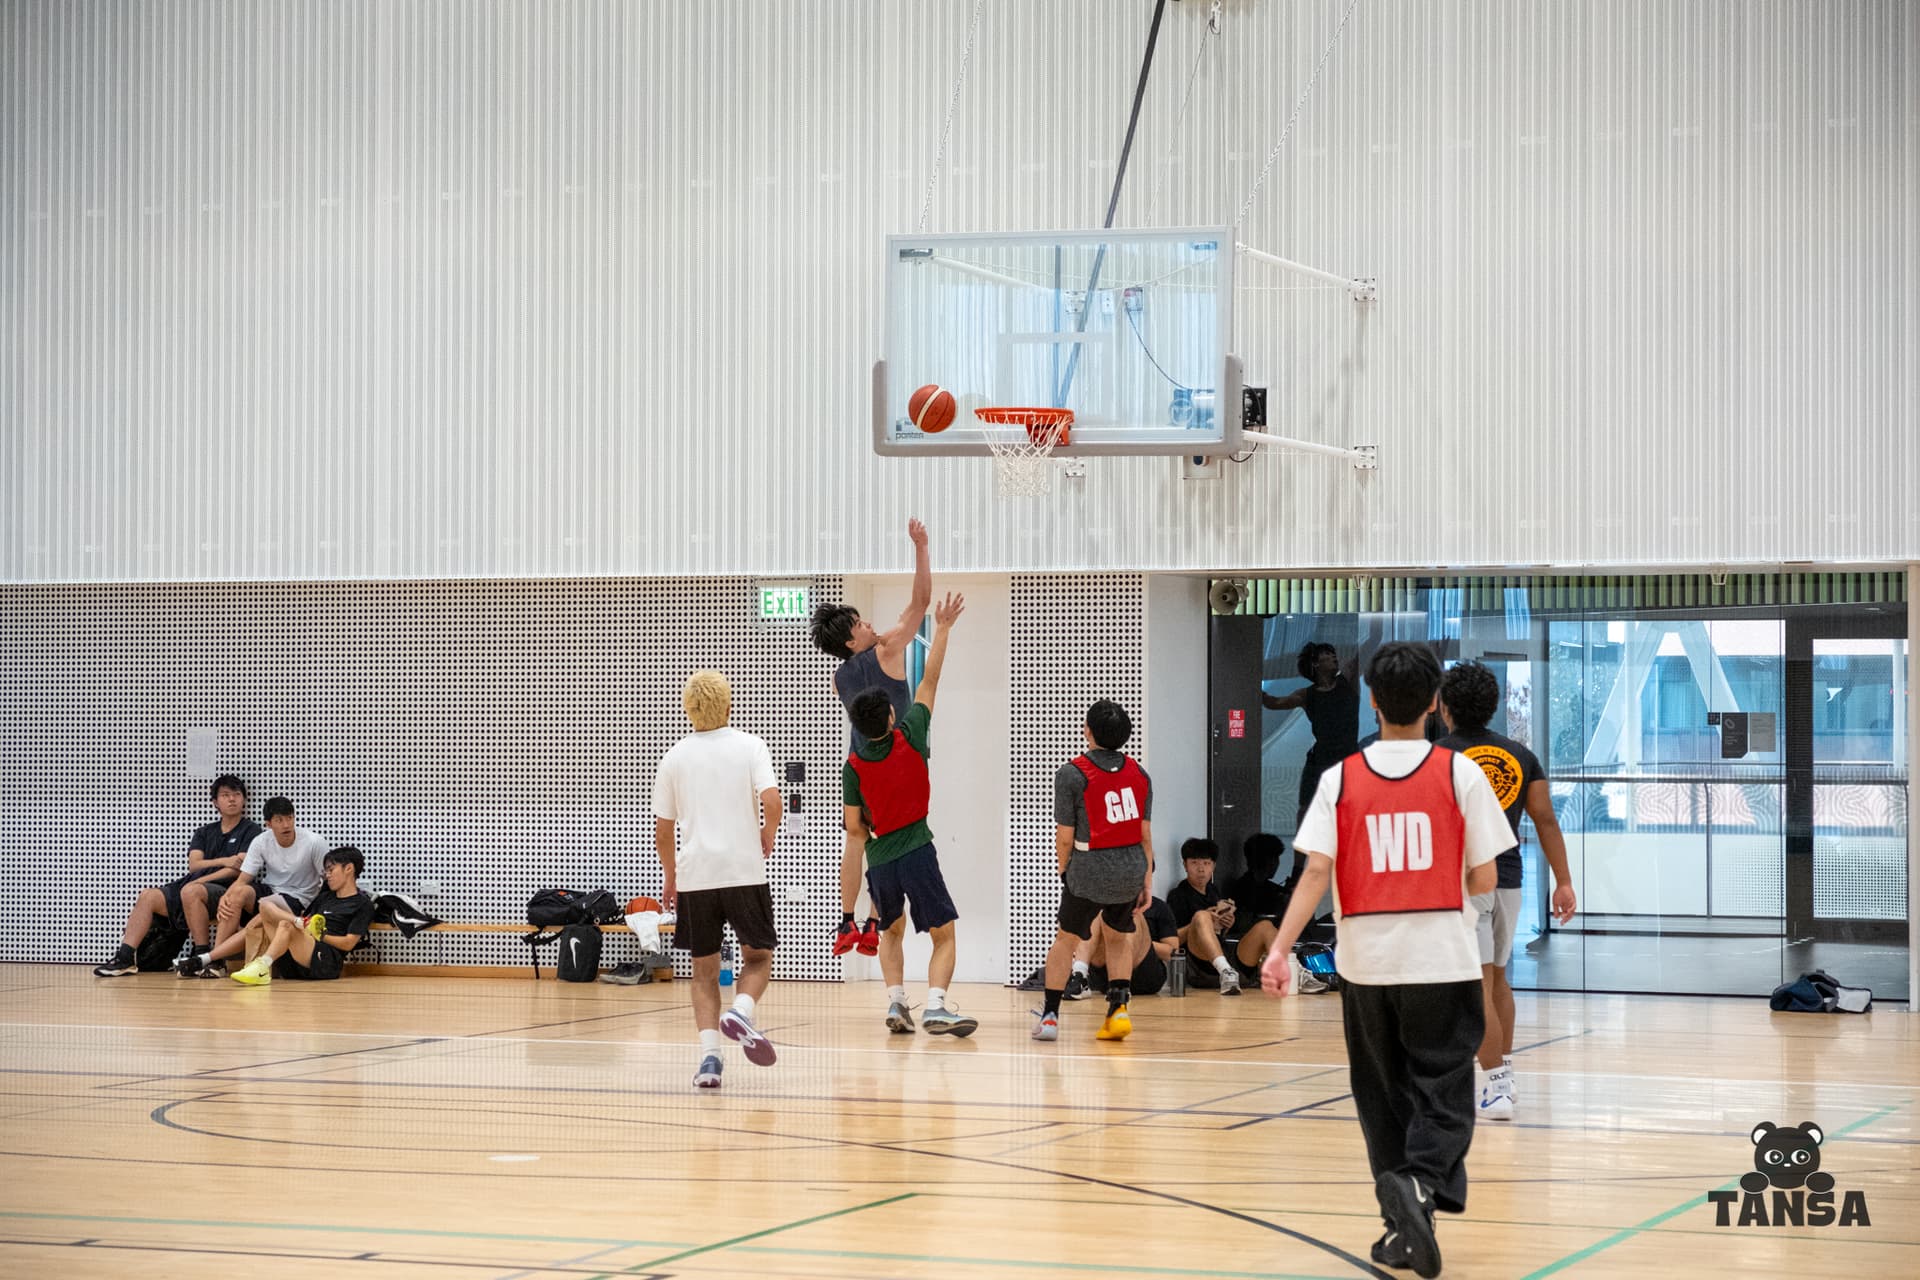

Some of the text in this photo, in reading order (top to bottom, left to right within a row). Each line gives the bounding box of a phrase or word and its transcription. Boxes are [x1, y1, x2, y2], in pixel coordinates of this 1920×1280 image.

[764, 591, 804, 614] Exit
[1104, 786, 1140, 824] GA
[1365, 811, 1433, 873] WD
